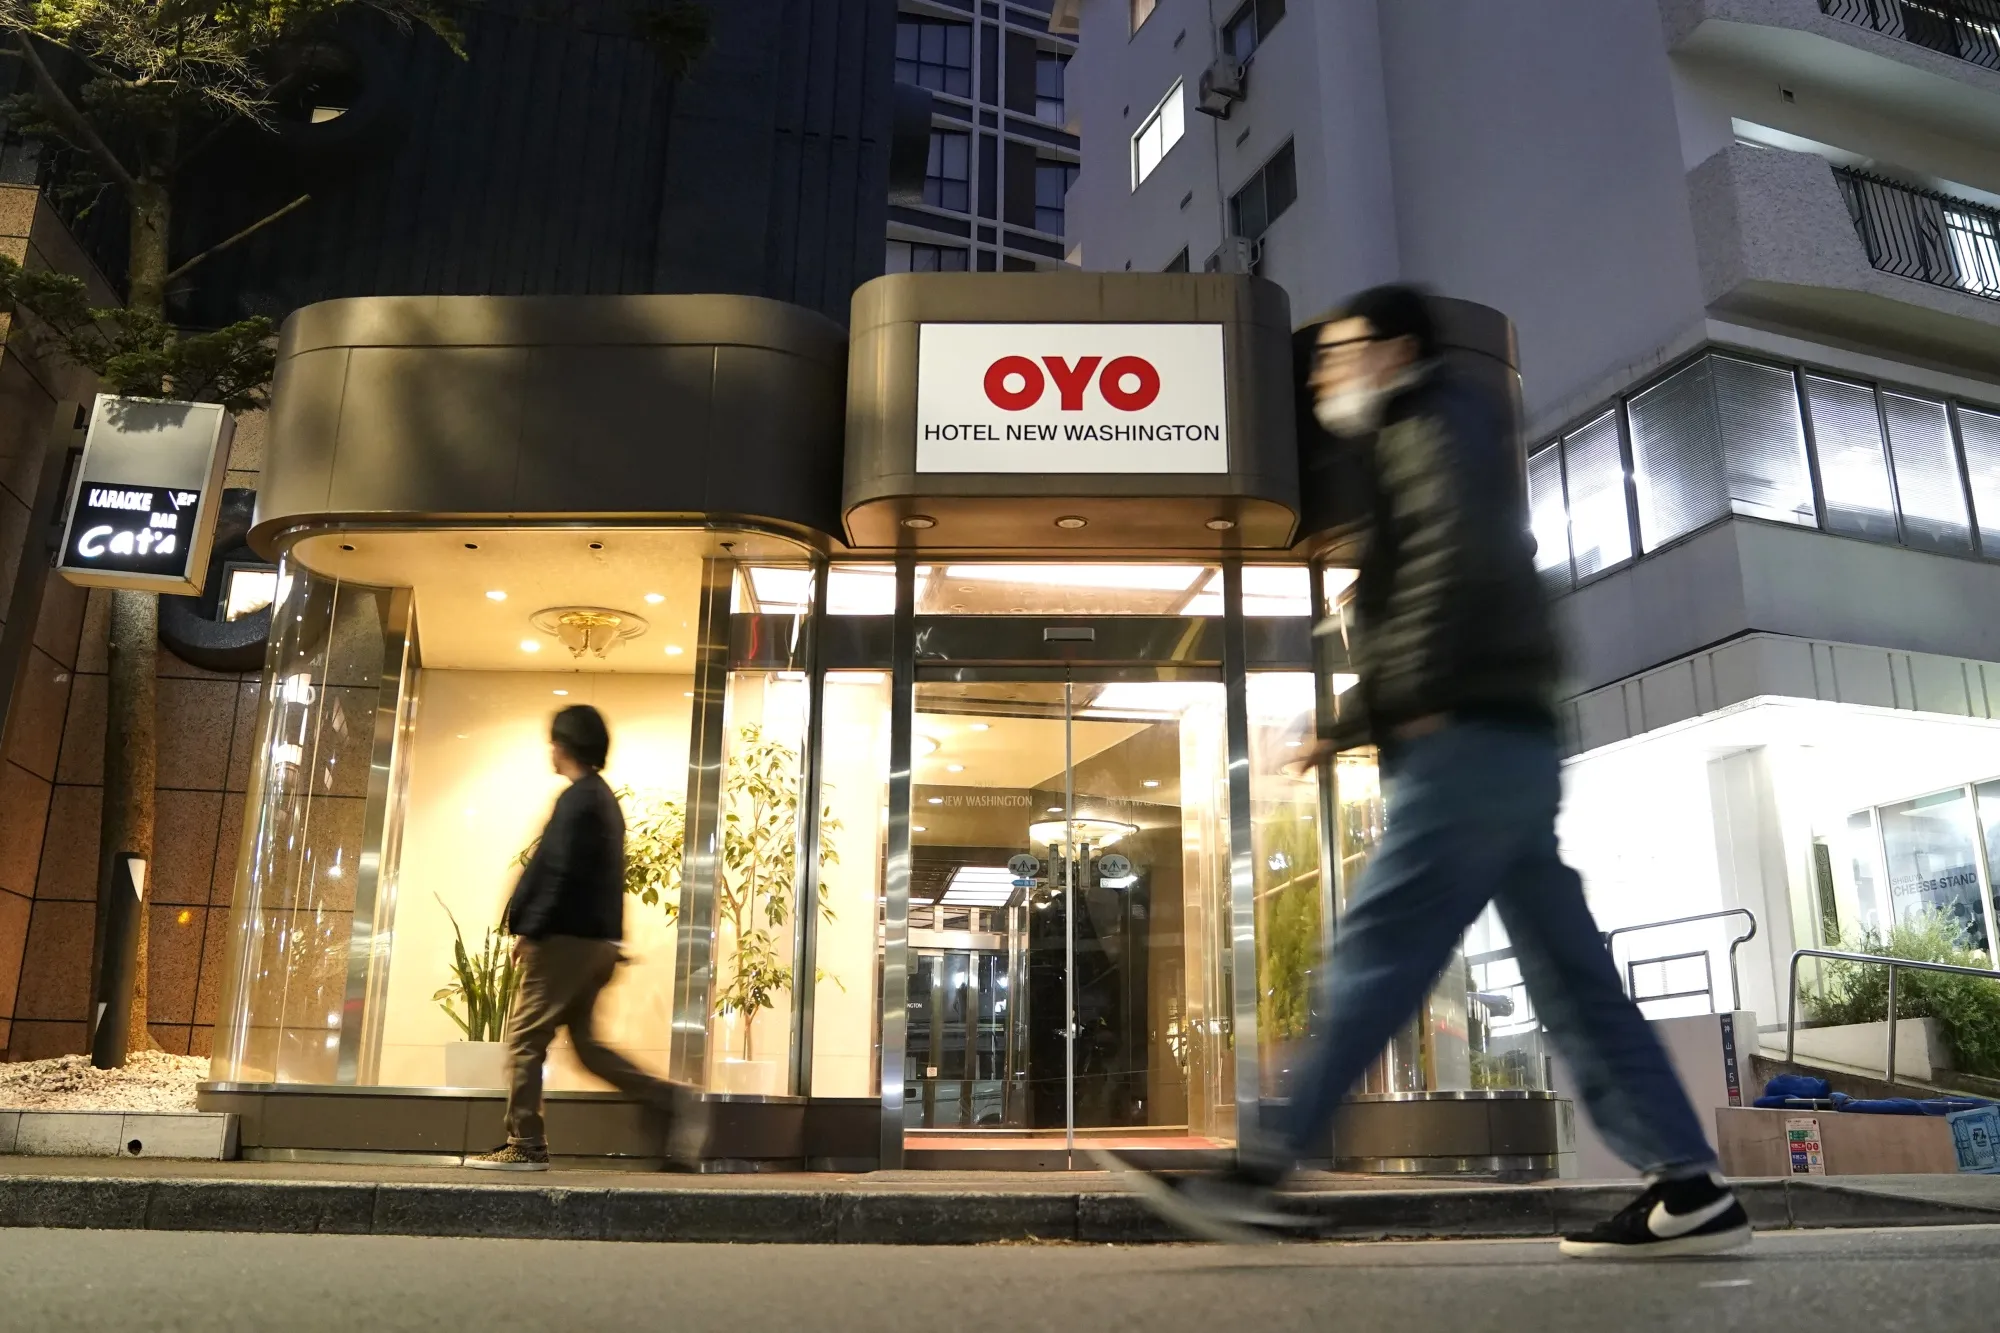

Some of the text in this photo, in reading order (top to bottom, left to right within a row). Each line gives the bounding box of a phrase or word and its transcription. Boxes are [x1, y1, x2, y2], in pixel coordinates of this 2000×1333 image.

[983, 355, 1161, 412] OYO
[924, 424, 1219, 441] HOTEL NEW WASHINGTON
[88, 489, 153, 511] KARAOKE
[149, 512, 178, 529] BAR
[965, 795, 1033, 807] WASHINGTON
[1892, 873, 1923, 885] SHIBUYA
[1893, 872, 1977, 897] CHEESE STAND
